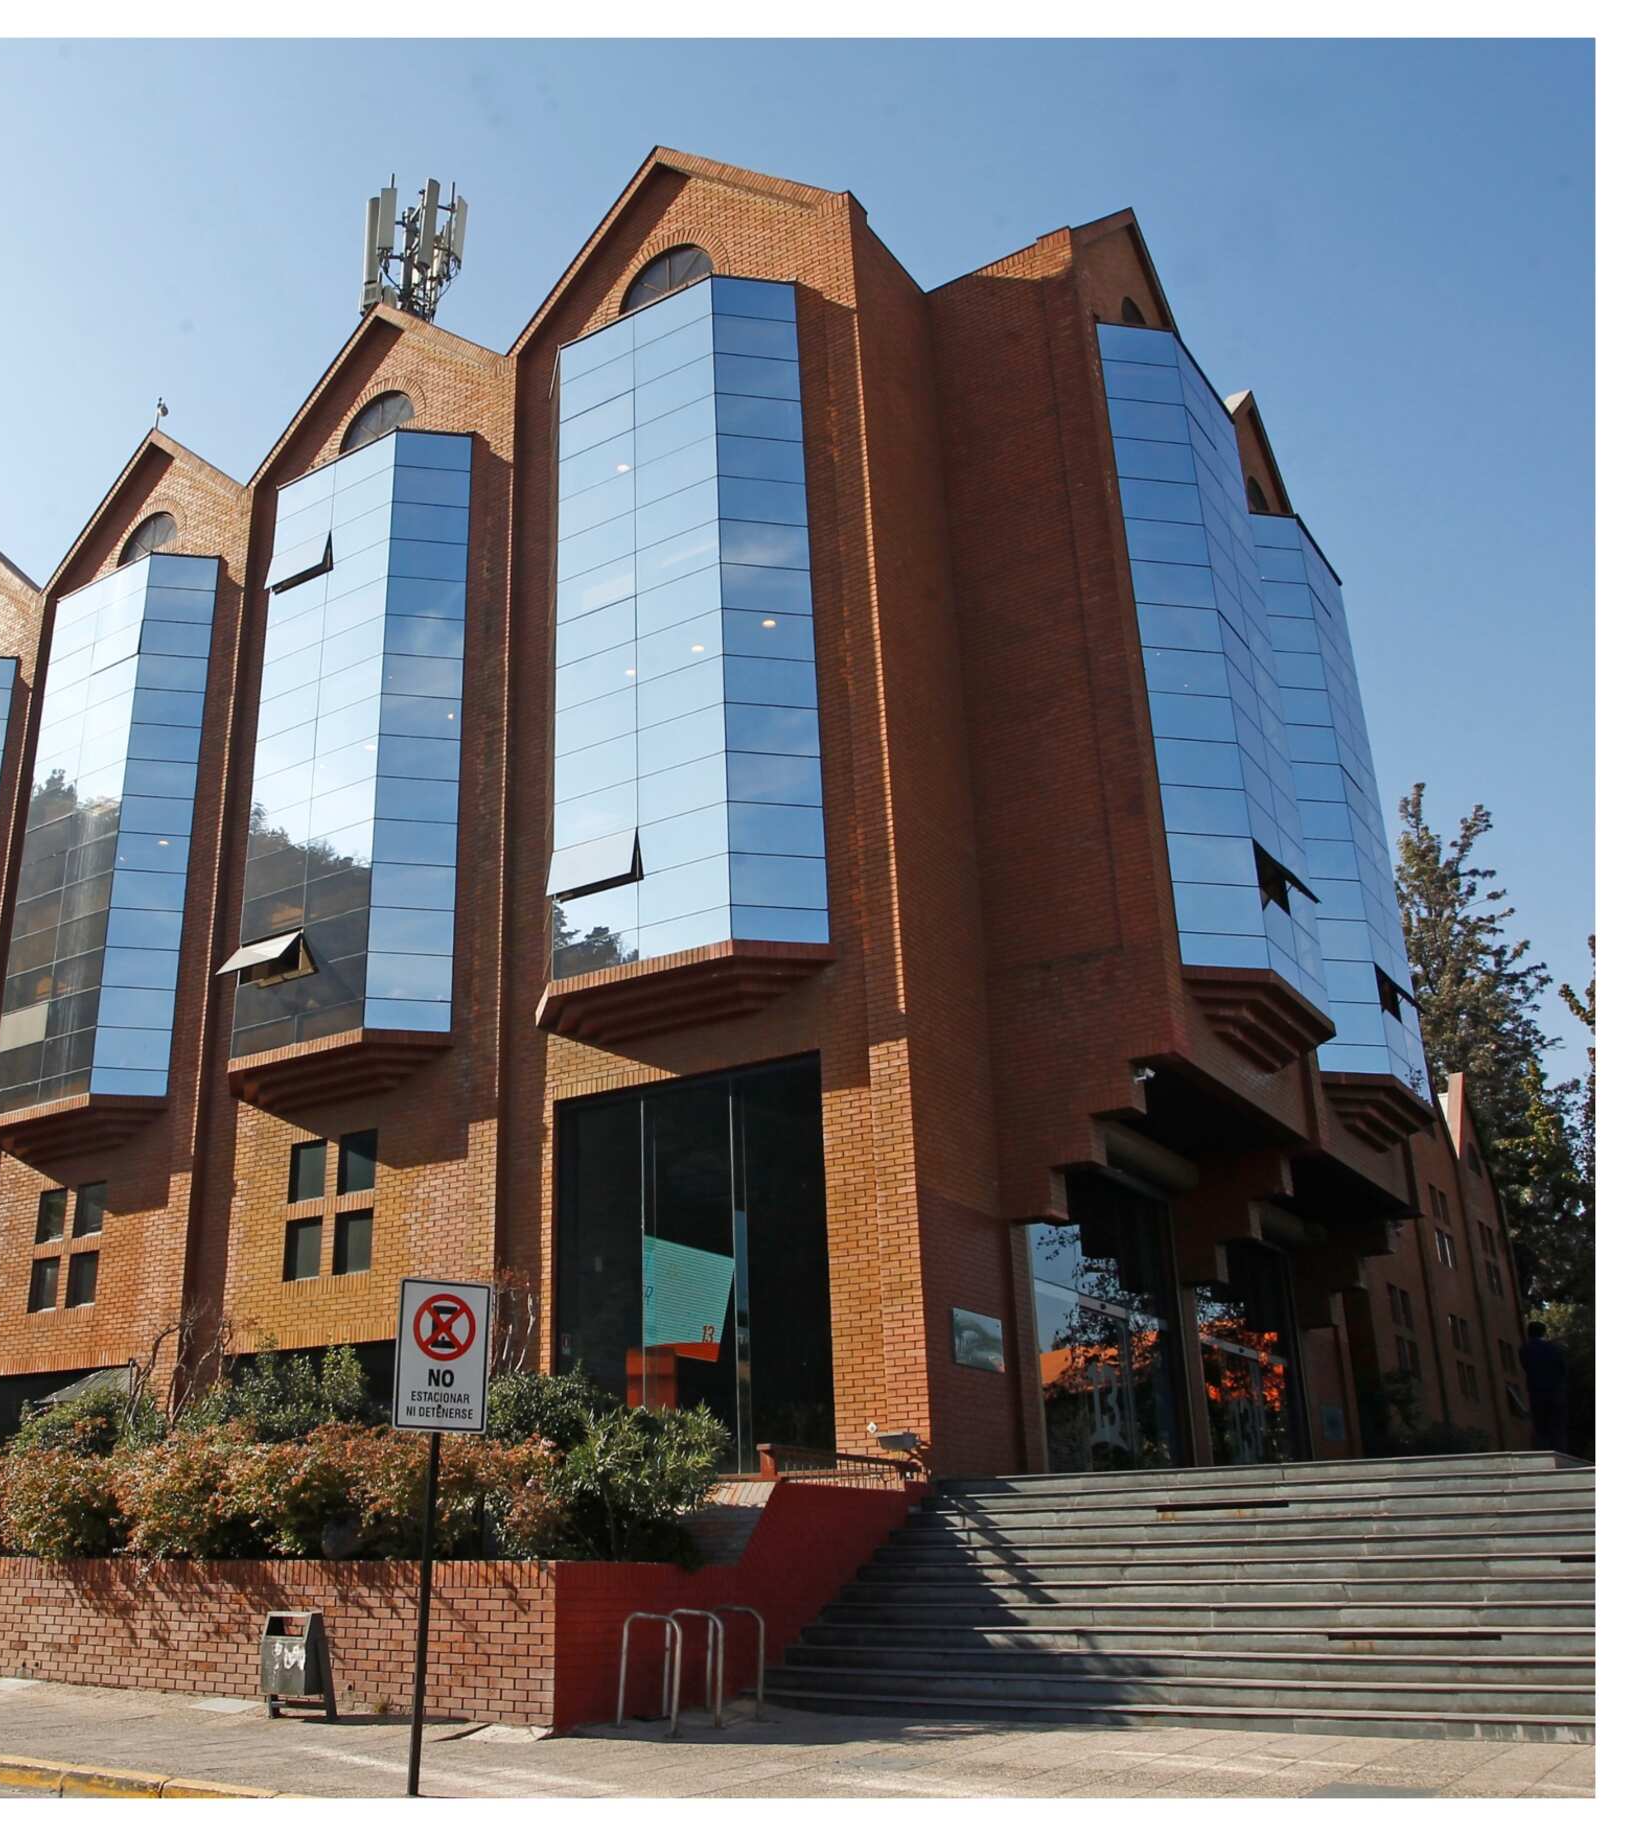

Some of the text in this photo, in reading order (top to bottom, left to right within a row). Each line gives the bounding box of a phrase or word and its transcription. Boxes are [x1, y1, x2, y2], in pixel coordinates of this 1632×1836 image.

[428, 1369, 454, 1388] NO
[411, 1390, 470, 1404] ESTACIONAR
[406, 1405, 473, 1419] NI DETENERSE
